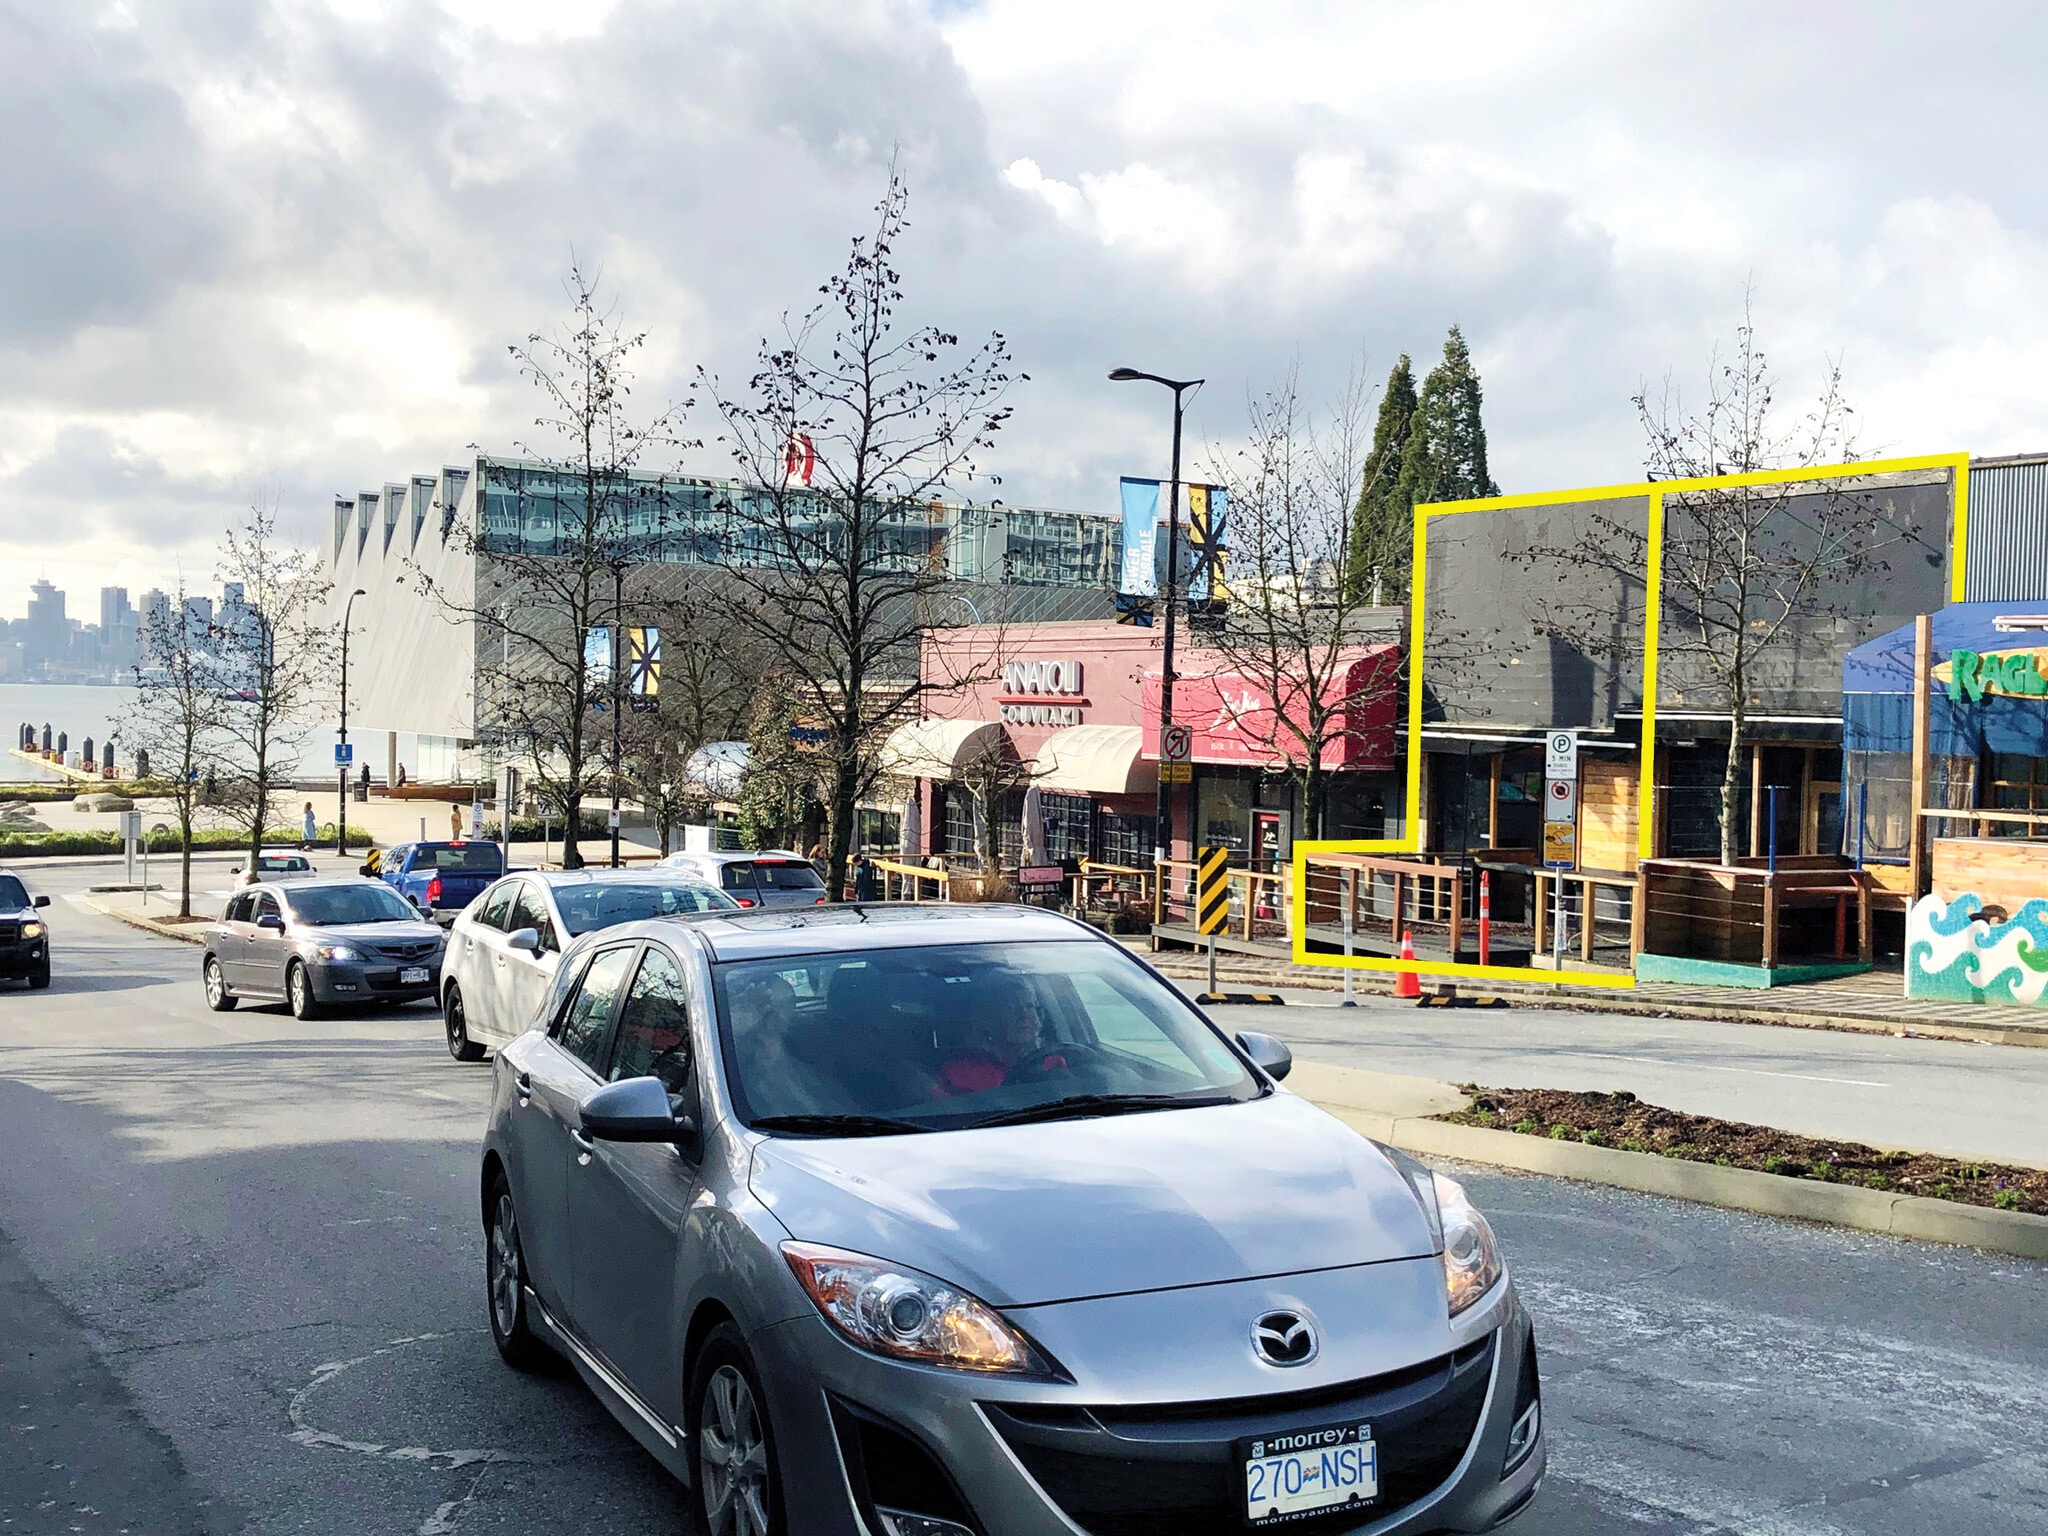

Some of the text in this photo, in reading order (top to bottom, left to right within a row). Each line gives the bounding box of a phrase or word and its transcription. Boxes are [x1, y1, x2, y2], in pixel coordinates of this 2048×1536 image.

[1001, 660, 1080, 693] ANATOLI
[1948, 648, 2048, 702] RAGL
[1000, 705, 1080, 726] SOUVLAKI
[1274, 1427, 1348, 1450] morrey
[1248, 1457, 1301, 1502] 270
[1321, 1445, 1376, 1489] NSH
[1256, 1498, 1374, 1526] morreyauto.com
